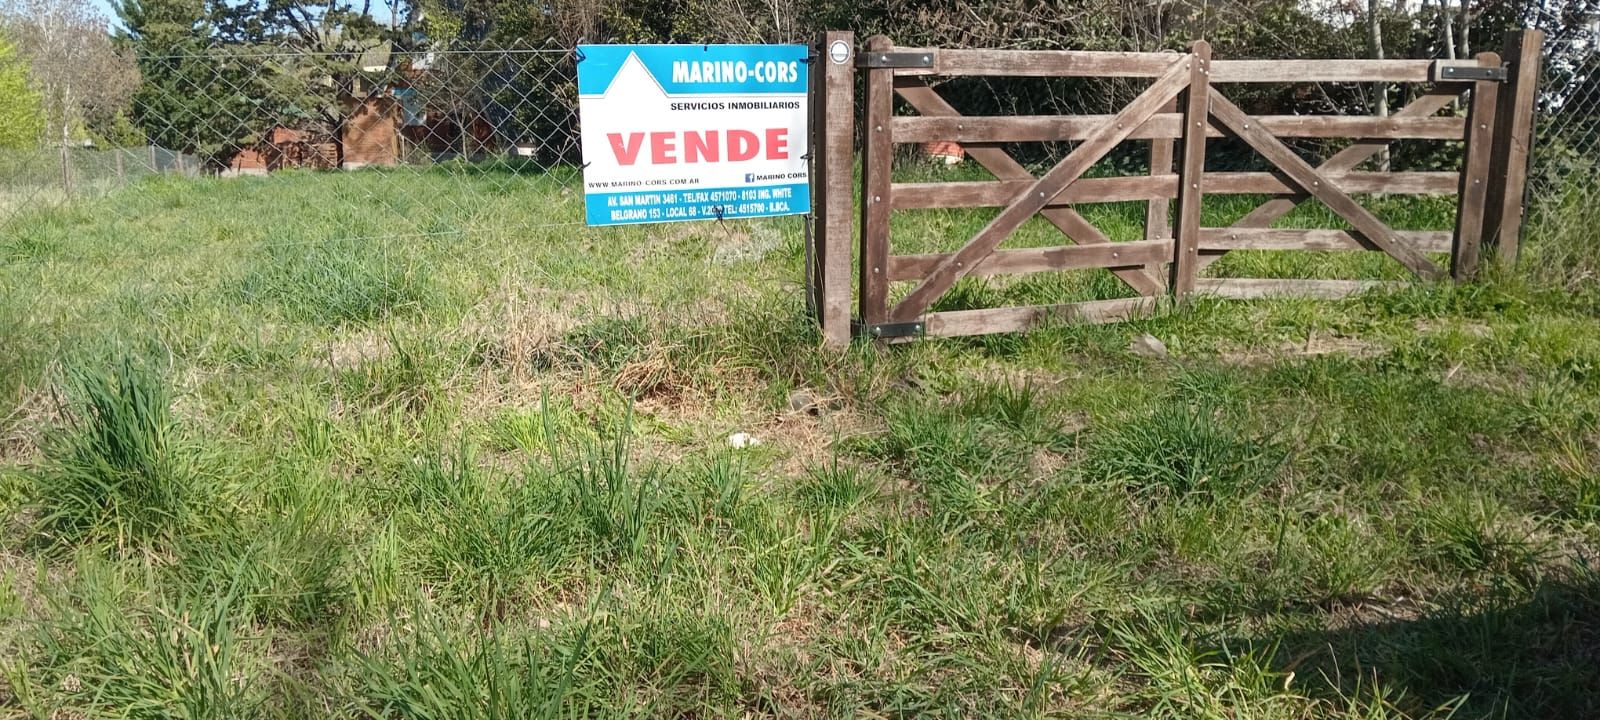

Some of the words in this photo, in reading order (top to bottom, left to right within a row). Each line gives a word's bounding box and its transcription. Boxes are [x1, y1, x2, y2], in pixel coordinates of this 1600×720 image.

[672, 60, 798, 83] MARINO-CORS
[670, 102, 725, 111] SERVICIOS
[728, 101, 800, 110] INMOBILIARIOS
[606, 128, 789, 166] VENDE
[756, 173, 785, 181] MARINO
[620, 195, 634, 206] SAN
[635, 194, 661, 206] MARTIN
[683, 191, 709, 203] TEL/FAX
[772, 188, 792, 198] WHITE
[610, 209, 648, 221] BELGRANO
[649, 208, 661, 219] 153
[665, 207, 688, 218] LOCAL
[724, 203, 737, 214] TEL:
